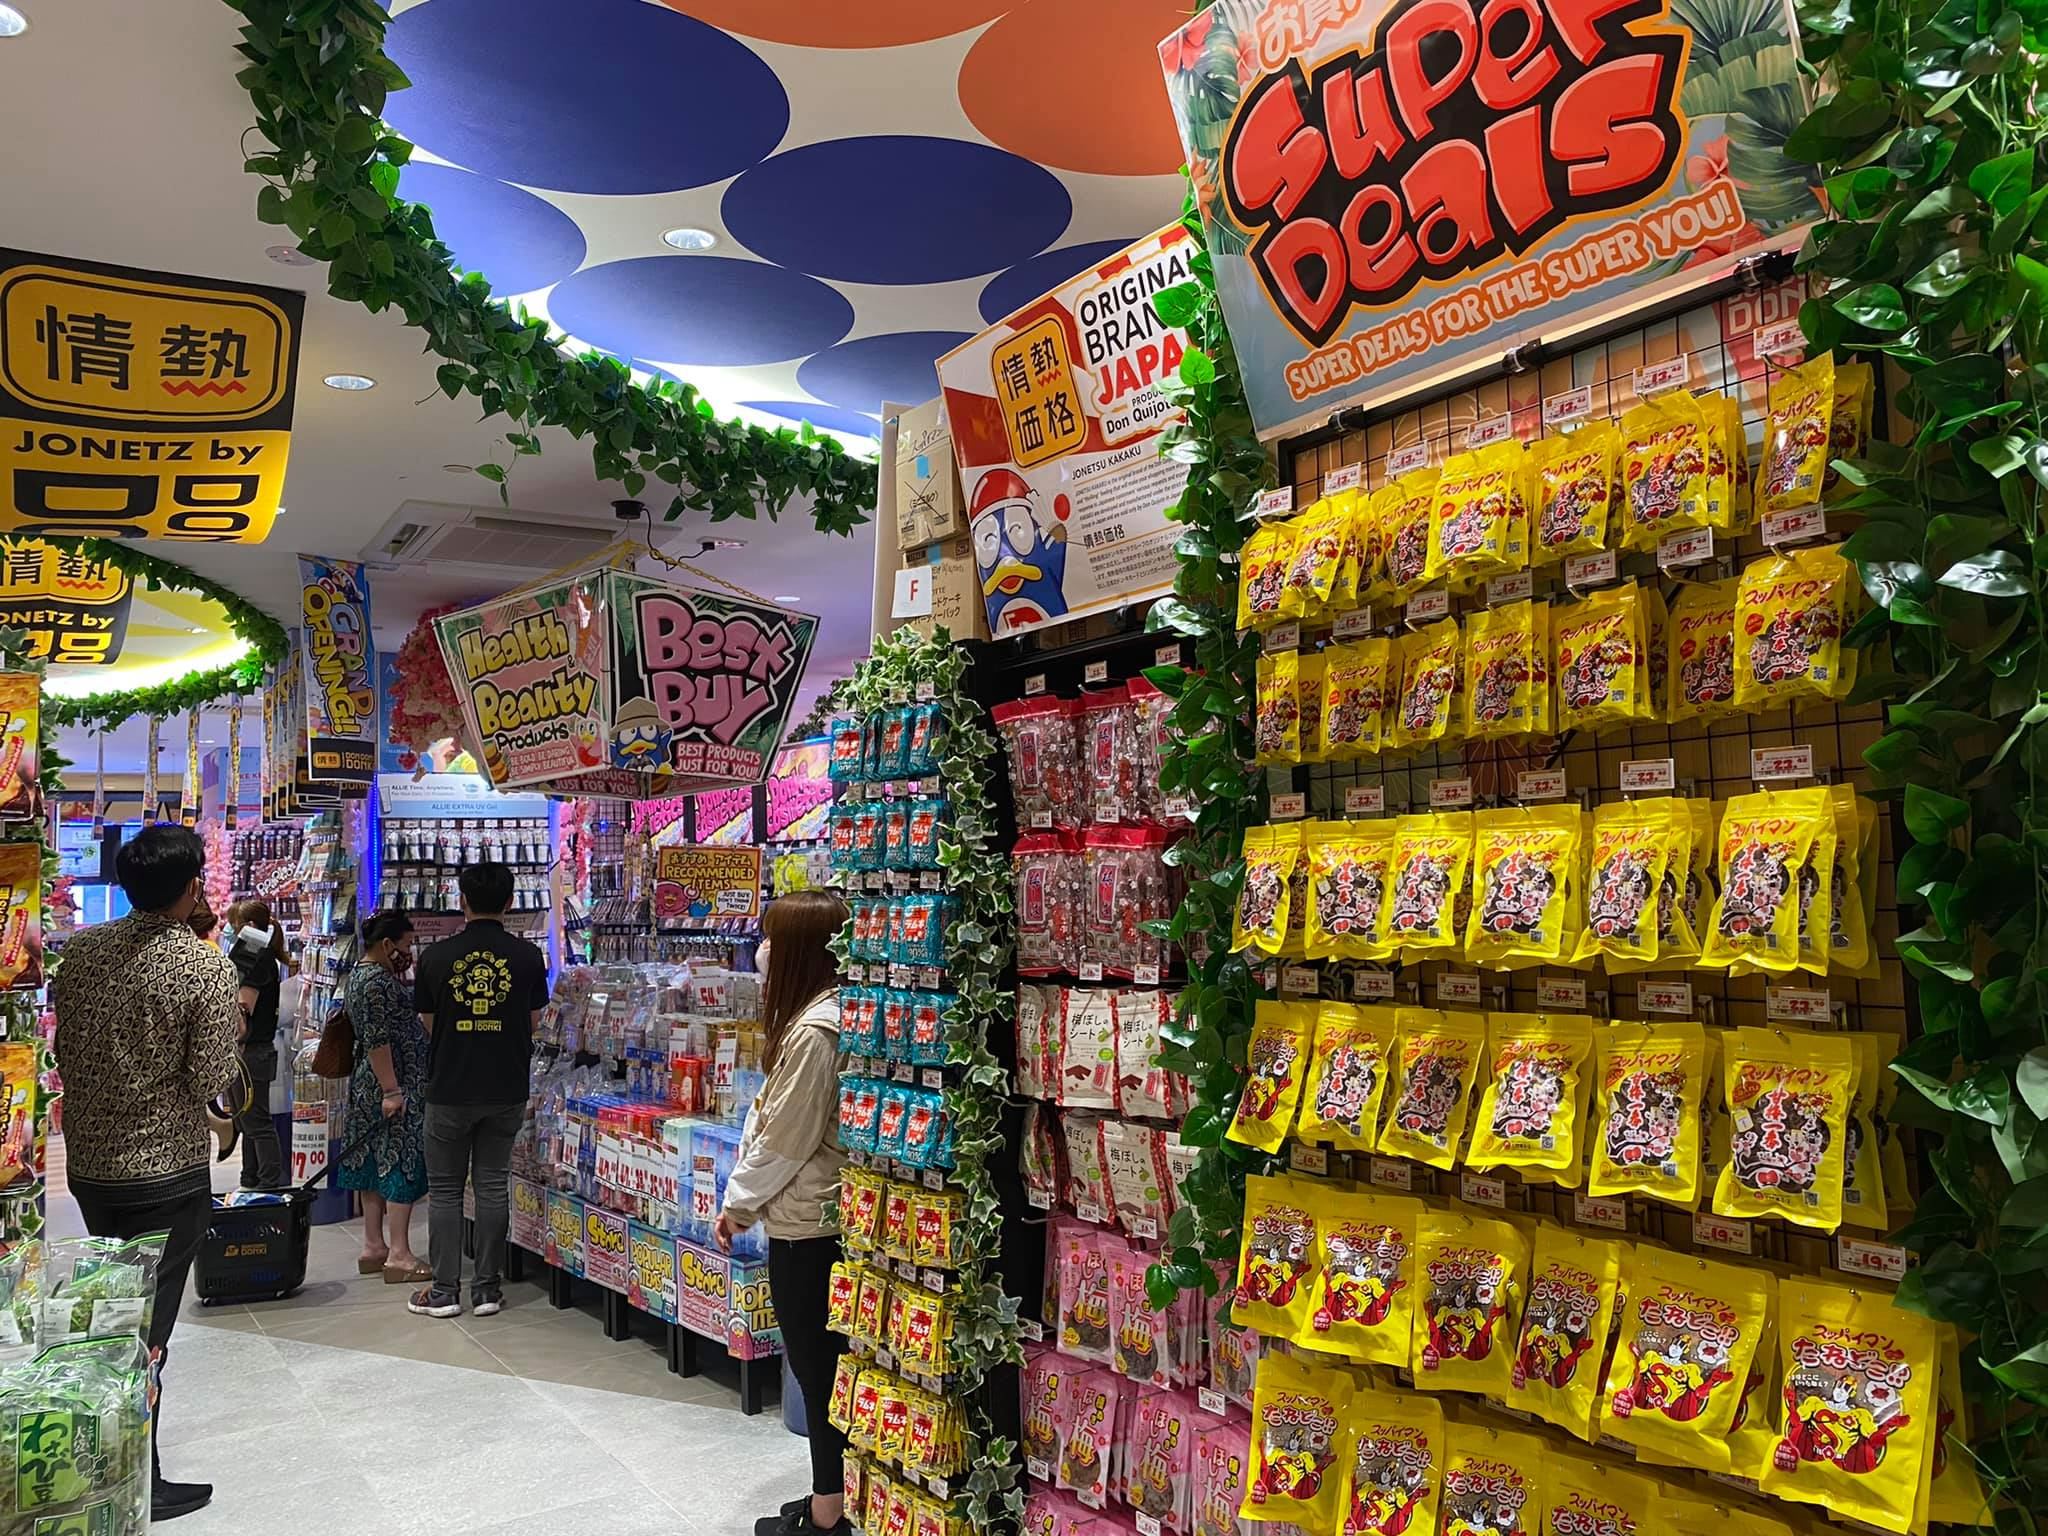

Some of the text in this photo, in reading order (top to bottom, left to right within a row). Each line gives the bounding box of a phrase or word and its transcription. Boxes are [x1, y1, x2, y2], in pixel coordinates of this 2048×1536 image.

[1289, 191, 1739, 393] SUPER DEALS FOR THE SUPER YOU!
[1106, 413, 1131, 434] Don
[14, 431, 263, 465] JONETZ by
[1071, 445, 1142, 481] JONETSU KAKAKU
[1440, 470, 1506, 496] スッパイマン
[1745, 579, 1838, 606] スッパイマン
[82, 613, 115, 630] by
[1560, 612, 1625, 641] スッパイマン
[457, 608, 571, 681] Health
[331, 602, 376, 718] GRAND
[472, 670, 599, 740] Beauty
[495, 722, 571, 752] Products
[678, 743, 761, 765] BEST PRODUCTS
[675, 757, 703, 772] JUST
[706, 759, 727, 774] FOR
[1600, 828, 1655, 845] スッパイマン
[1732, 818, 1798, 838] スッパイマン
[1402, 837, 1458, 850] スッパイマン
[1488, 832, 1557, 848] スッパイマン
[665, 865, 756, 879] RECOMMENDED
[1069, 1029, 1096, 1042] シート
[1122, 1036, 1144, 1050] シート
[1324, 1025, 1377, 1043] スッパイマン
[1408, 1035, 1468, 1051] スッパイマン
[1502, 1040, 1572, 1055] スッパイマン
[1608, 1051, 1684, 1070] スッパイマン
[1741, 1065, 1829, 1085] スッパイマン
[1110, 1165, 1138, 1178] シート
[587, 1212, 626, 1254] Store
[1340, 1220, 1395, 1236] スッパイマン
[631, 1239, 674, 1280] POPULAR
[1438, 1245, 1496, 1262] スッパイマン
[681, 1250, 727, 1299] Store
[1657, 1285, 1732, 1313] スッパイマン
[1812, 1324, 1895, 1351] スッパイマン
[1277, 1392, 1329, 1408] スッパイマン
[1371, 1424, 1426, 1441] スッパイマン
[1464, 1458, 1518, 1478] スッパイマン
